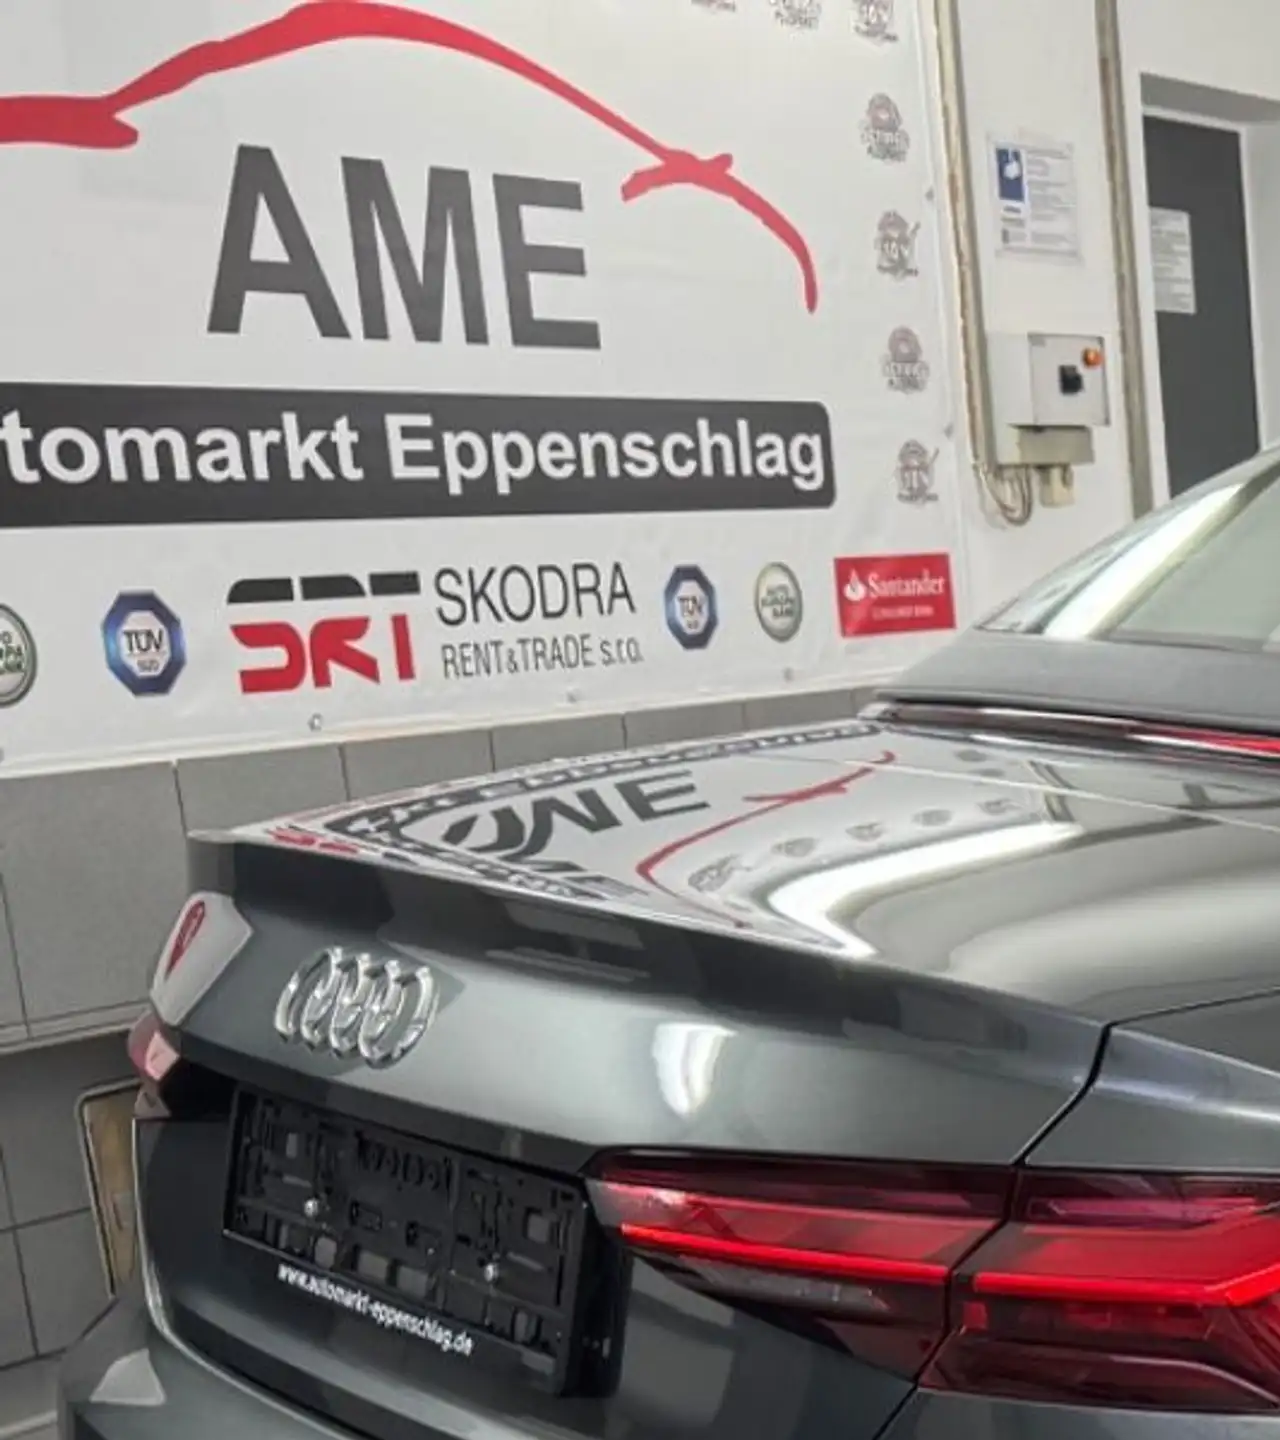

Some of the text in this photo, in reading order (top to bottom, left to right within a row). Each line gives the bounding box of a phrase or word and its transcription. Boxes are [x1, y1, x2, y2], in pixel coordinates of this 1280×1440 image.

[207, 143, 601, 349] AME
[0, 410, 364, 484] tomarkt
[384, 413, 826, 496] Eppenschlag
[434, 561, 637, 627] SKODRA
[867, 567, 945, 600] Santander
